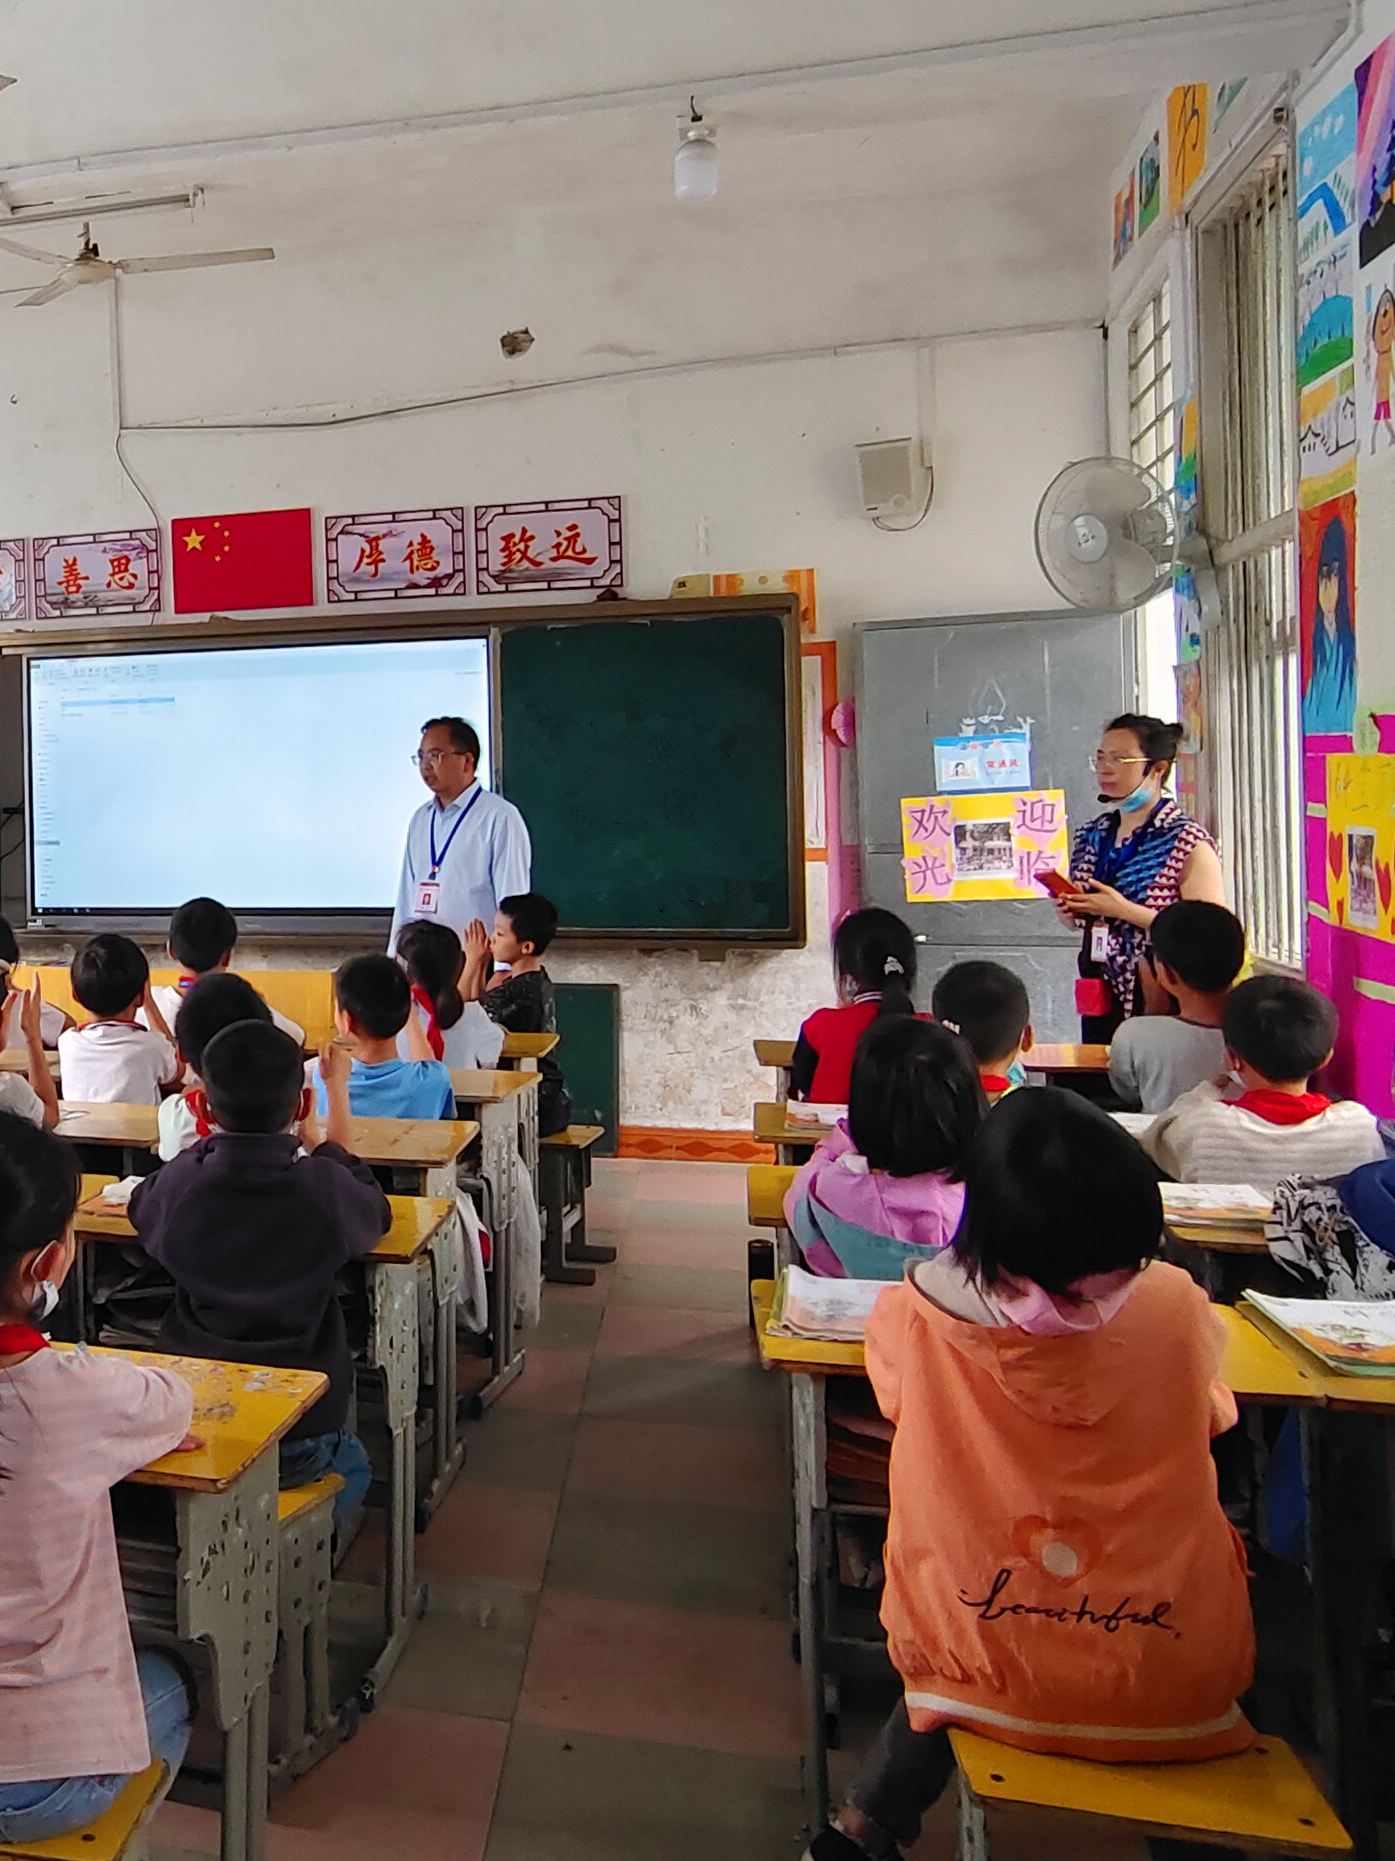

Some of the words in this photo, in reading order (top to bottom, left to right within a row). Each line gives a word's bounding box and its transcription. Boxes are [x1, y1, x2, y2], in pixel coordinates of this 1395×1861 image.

[352, 532, 442, 579] 厚德
[499, 522, 599, 569] 致远
[55, 554, 139, 596] 善思
